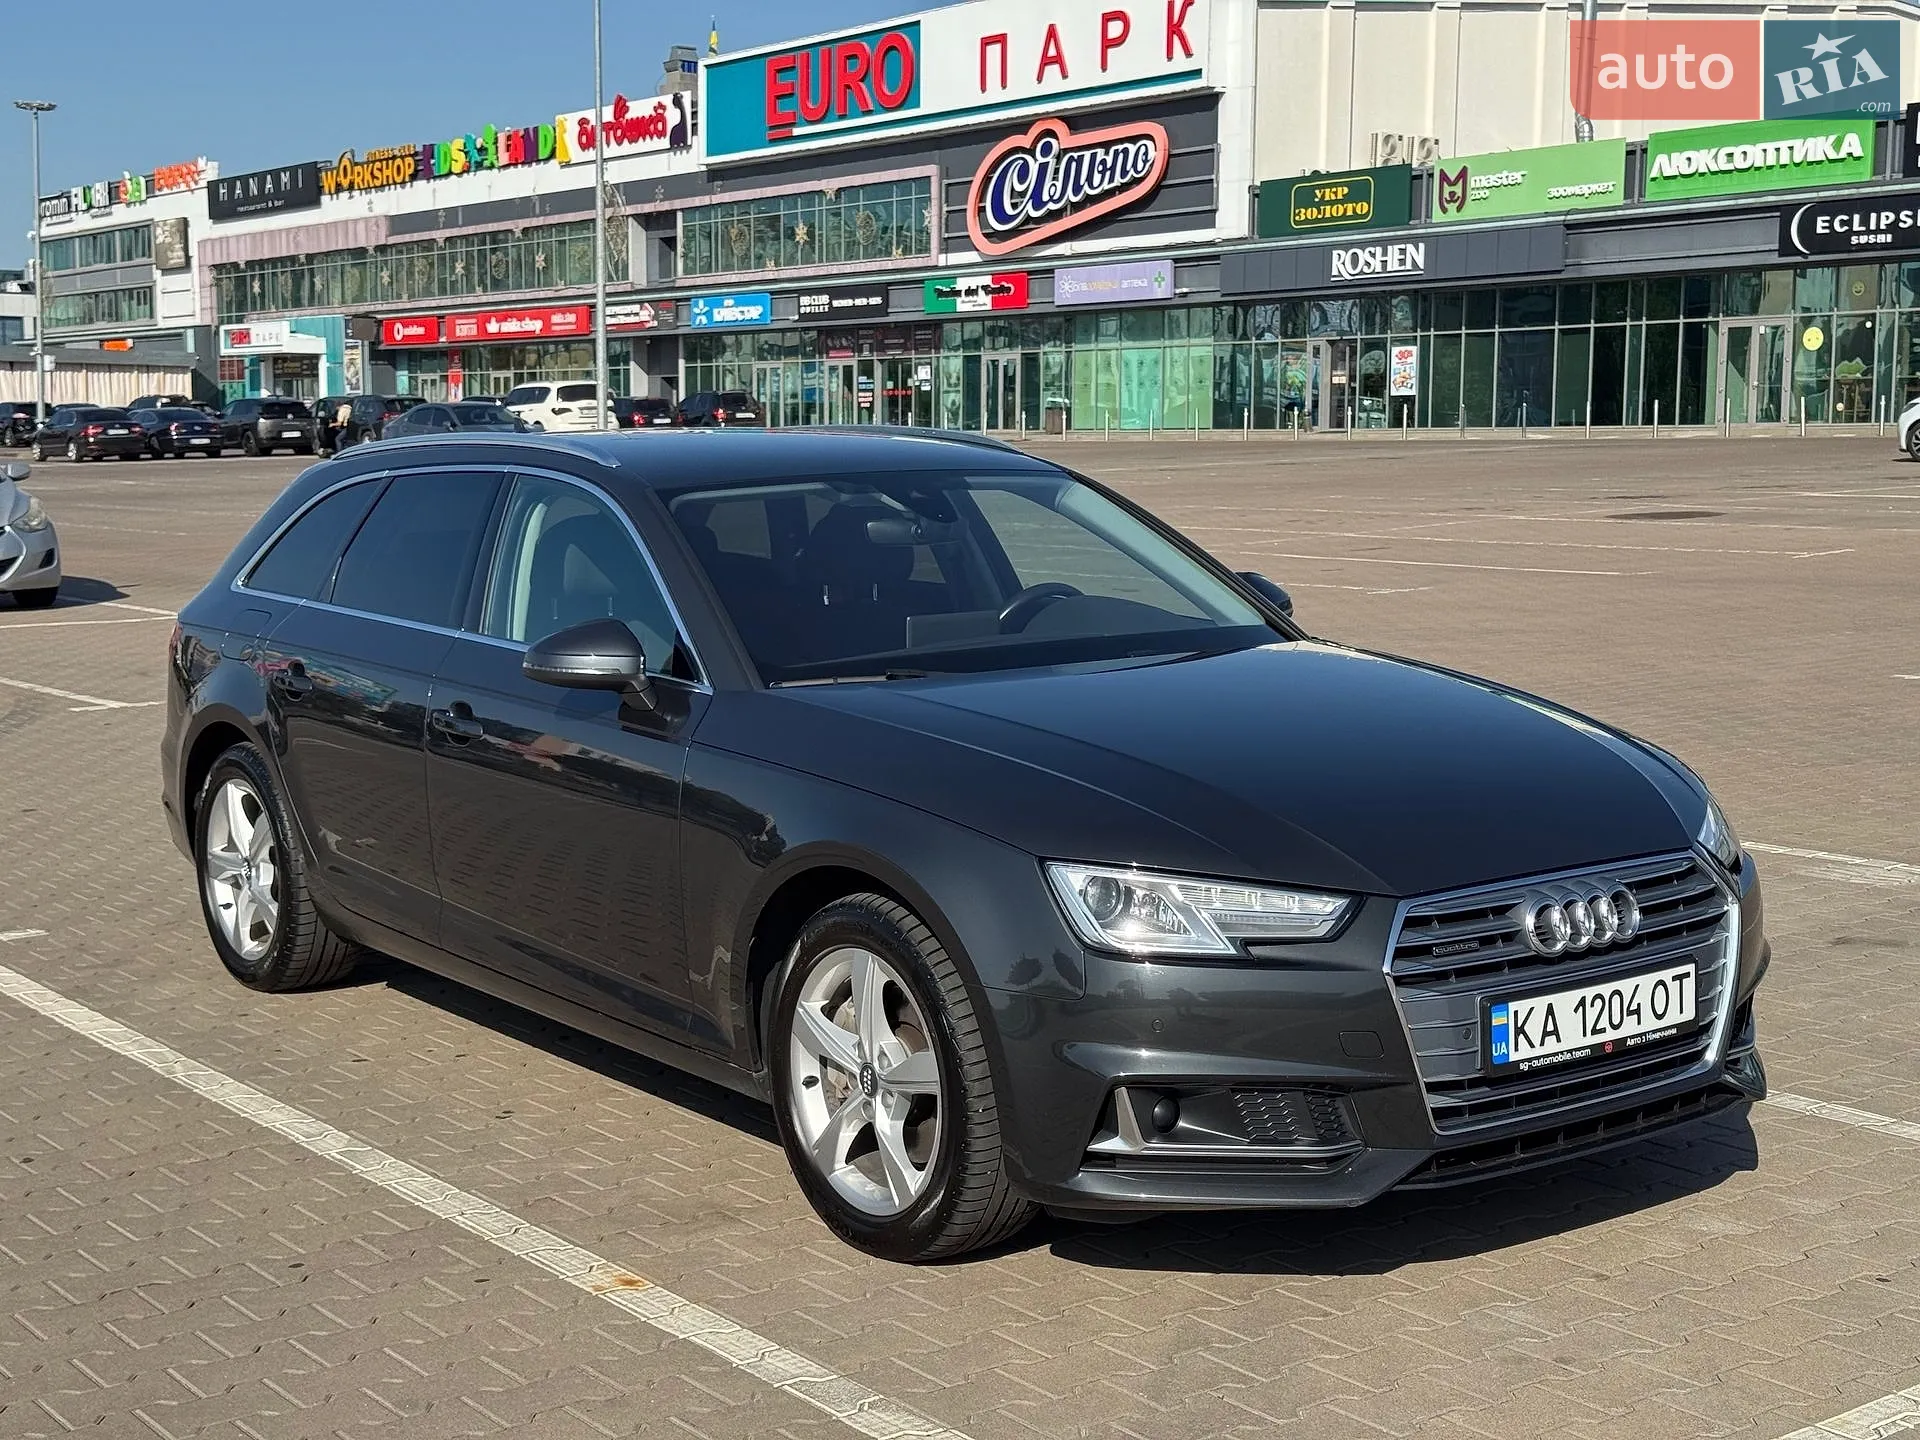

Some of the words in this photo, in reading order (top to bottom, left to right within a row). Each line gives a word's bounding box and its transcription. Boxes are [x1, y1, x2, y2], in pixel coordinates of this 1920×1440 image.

[766, 31, 916, 132] EURO
[980, 0, 1194, 92] ПАРК
[1649, 133, 1864, 179] ЛЮКСОПТИКА
[219, 168, 304, 202] HANAMI
[321, 157, 415, 195] WORKSHOP
[986, 138, 1156, 231] Сільпо
[1471, 170, 1527, 189] master
[1314, 186, 1349, 202] УКР
[1547, 181, 1617, 199] зоомаркет
[1294, 202, 1370, 221] ЗОЛОТО
[1815, 209, 1920, 235] ECLIPS
[1850, 233, 1893, 245] SUSHI
[1330, 242, 1425, 281] ROSHEN
[800, 305, 830, 314] OUTLET
[1513, 1003, 1562, 1052] KA
[1573, 984, 1642, 1038] 1204
[1650, 972, 1691, 1021] OT
[1492, 1041, 1508, 1056] UA
[1626, 1037, 1642, 1047] Авто
[1519, 1048, 1592, 1071] sg-automobile.team
